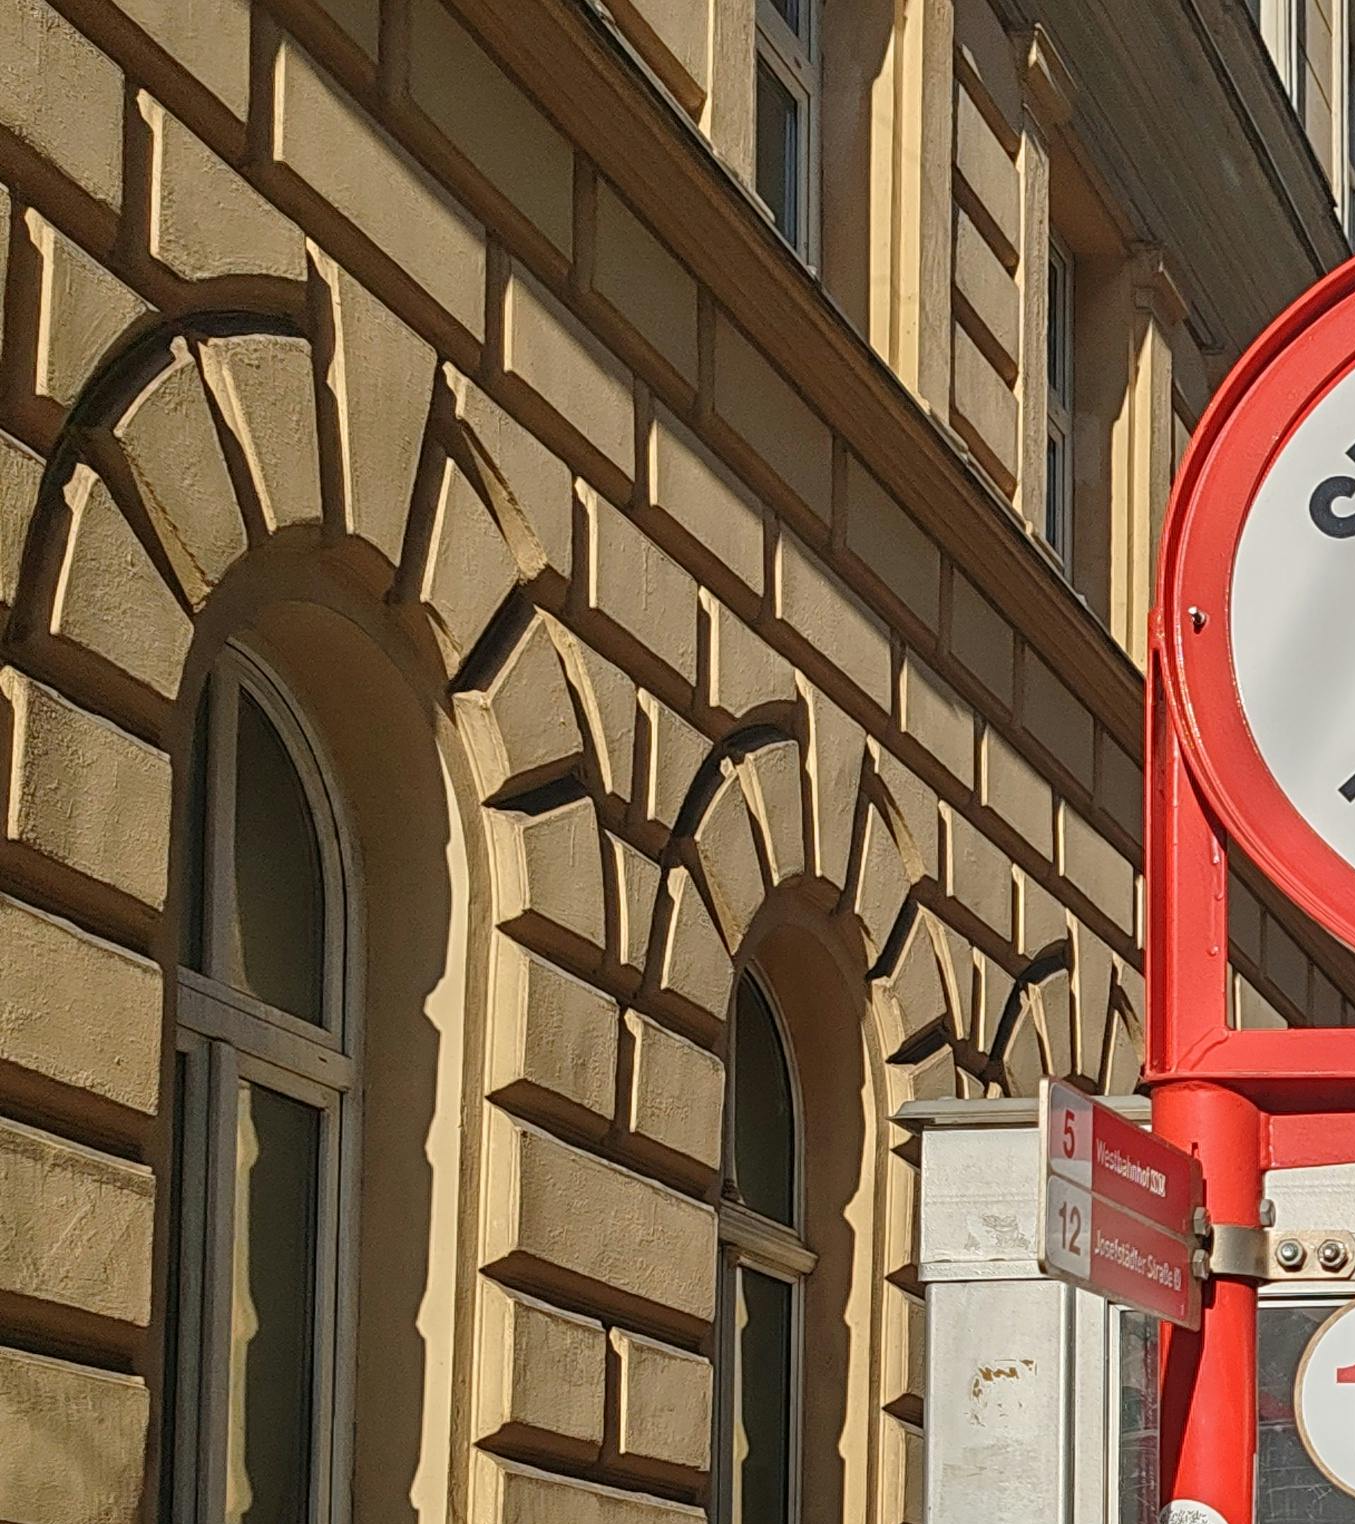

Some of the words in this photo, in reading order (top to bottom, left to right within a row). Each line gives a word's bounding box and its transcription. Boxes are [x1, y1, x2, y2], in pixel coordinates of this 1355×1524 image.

[1062, 1109, 1076, 1159] 5
[1095, 1137, 1151, 1190] Westbahnhof
[1058, 1201, 1082, 1257] 12
